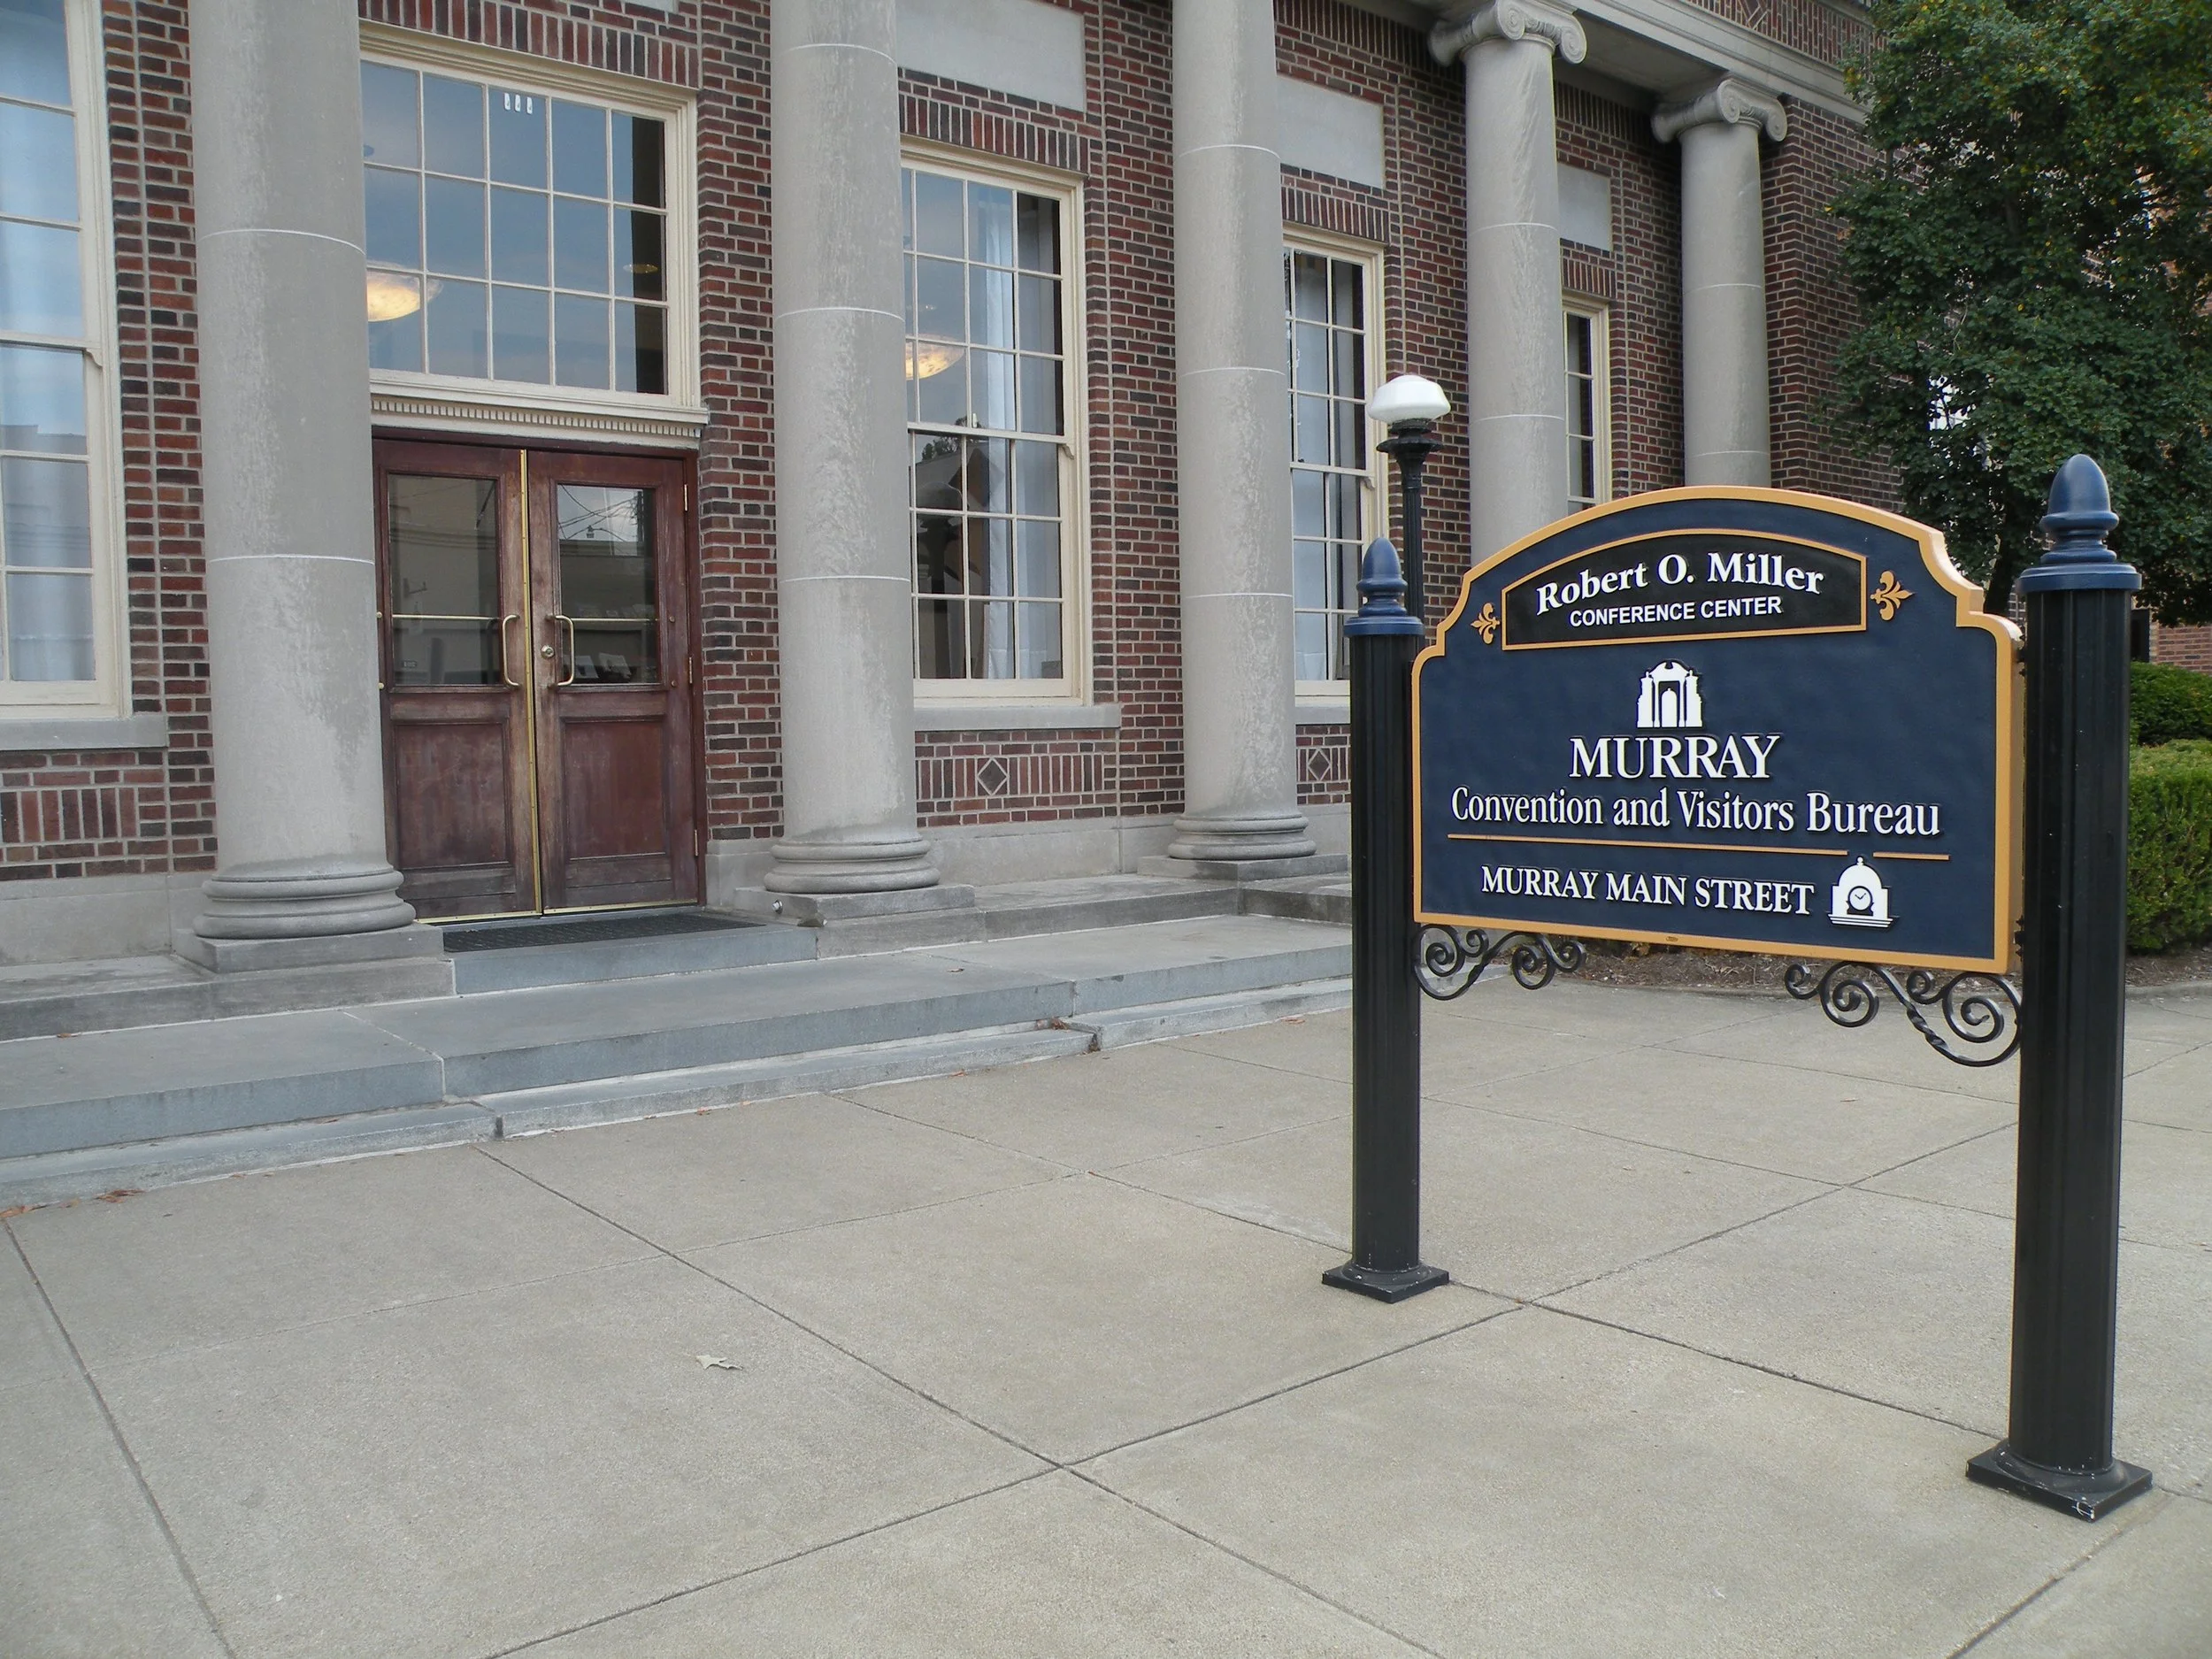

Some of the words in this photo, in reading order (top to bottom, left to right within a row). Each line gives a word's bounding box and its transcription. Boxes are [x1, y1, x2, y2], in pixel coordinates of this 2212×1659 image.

[1536, 563, 1648, 616] Robert
[1658, 554, 1694, 585] O.
[1707, 552, 1824, 595] Miller
[1570, 602, 1696, 627] CONFERENCE
[1701, 595, 1782, 618] CENTER
[1569, 734, 1780, 779] MURRAY
[1452, 787, 1604, 825] Convention
[1613, 787, 1671, 827] and
[1676, 790, 1794, 832] Visitors
[1806, 792, 1940, 835] Bureau
[1481, 865, 1599, 900] MURRAY
[1605, 872, 1687, 906] MAIN
[1694, 878, 1815, 915] STREET
